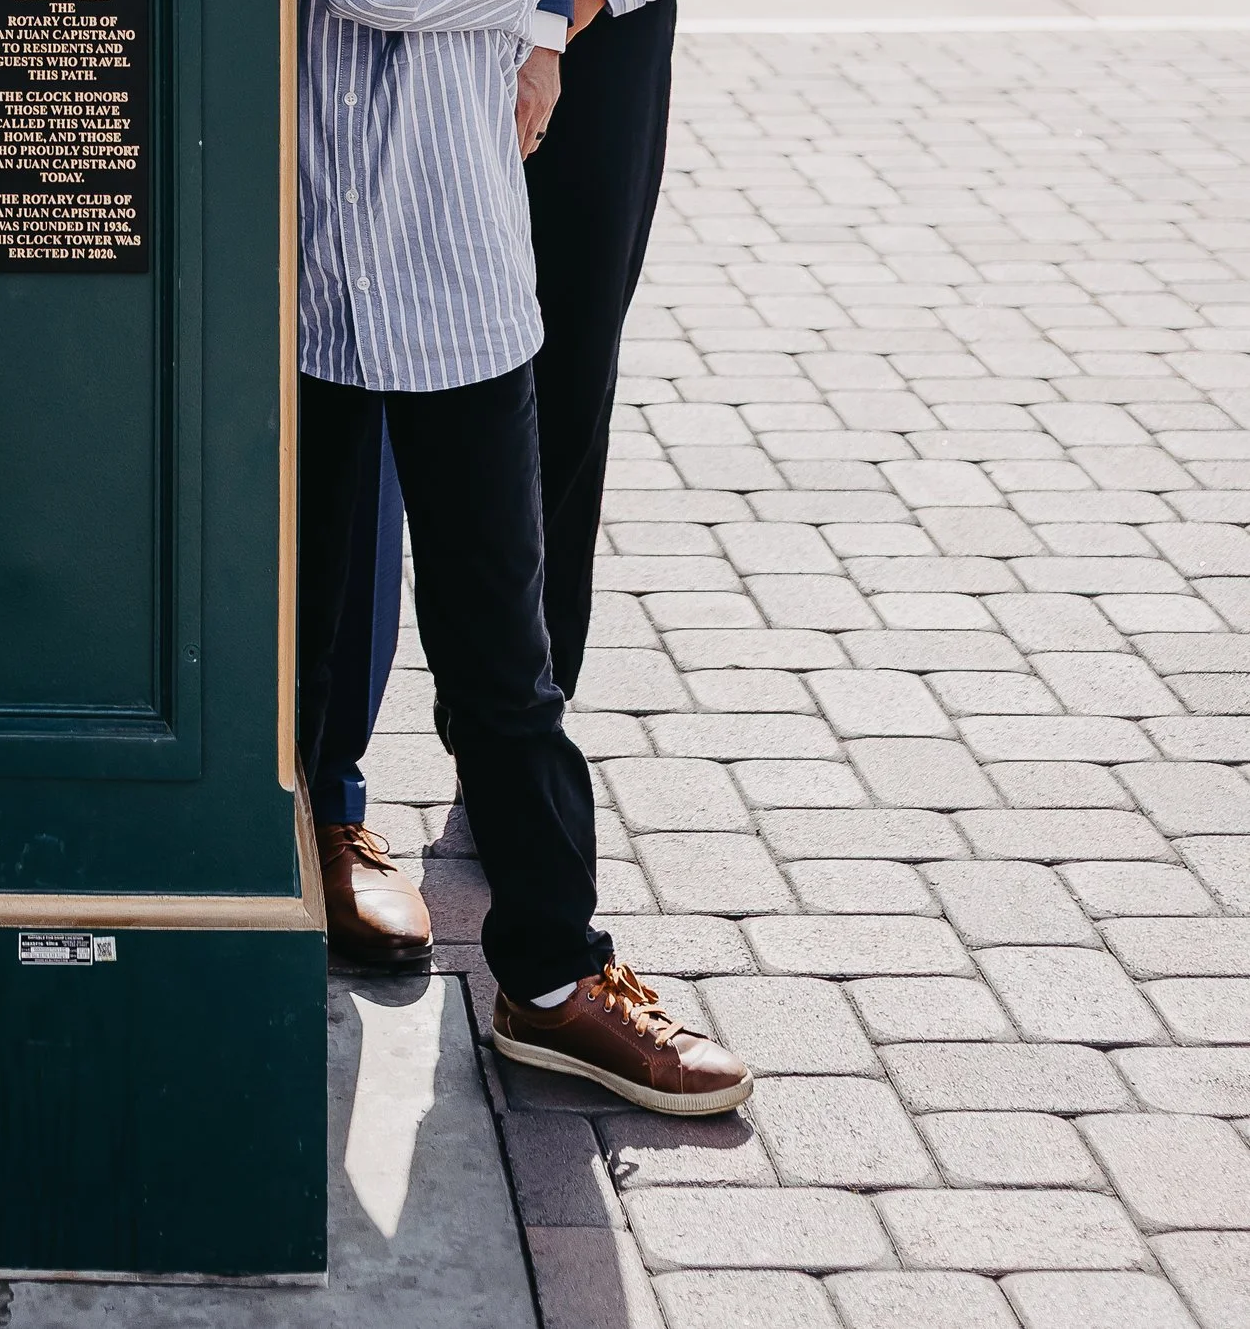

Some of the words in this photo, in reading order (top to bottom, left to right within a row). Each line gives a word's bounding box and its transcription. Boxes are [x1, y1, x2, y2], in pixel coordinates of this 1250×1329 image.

[49, 3, 75, 13] THE
[8, 16, 60, 26] ROTARY
[63, 16, 97, 26] CLUB
[100, 16, 117, 27] OF
[17, 30, 49, 39] JUAN
[53, 30, 135, 40] CAPISTRANO
[2, 43, 20, 53] TO
[23, 43, 93, 53] RESIDENTS
[95, 43, 123, 53] AND
[46, 57, 78, 67] WHO
[80, 57, 130, 67] TRAVEL
[28, 70, 58, 80] THIS
[61, 70, 97, 80] PATH.
[26, 91, 72, 102] CLOCK
[75, 92, 128, 102] HONORS
[5, 105, 47, 115] THOSE
[50, 105, 83, 115] WHO
[86, 105, 120, 115] HAVE
[48, 119, 78, 129] THIS
[80, 119, 130, 129] VALLEY
[4, 132, 46, 143] HOME,
[49, 132, 76, 142] AND
[78, 132, 121, 142] THOSE
[20, 145, 80, 156] PROUDLY
[82, 146, 140, 156] SUPPORT
[16, 159, 49, 169] JUAN
[52, 159, 136, 169] CAPISTRANO
[40, 172, 84, 182] TODAY.
[23, 194, 74, 204] ROTARY
[77, 194, 111, 205] CLUB
[114, 195, 132, 205] OF
[16, 208, 49, 218] JUAN
[52, 208, 136, 218] CAPISTRANO
[23, 221, 83, 231] FOUNDED
[87, 222, 100, 231] IN
[104, 222, 131, 232] 1936.
[17, 235, 62, 245] CLOCK
[65, 235, 112, 245] TOWER
[114, 235, 141, 246] WAS
[9, 248, 69, 258] ERECTED
[72, 248, 85, 258] IN
[88, 248, 117, 259] 2020.
